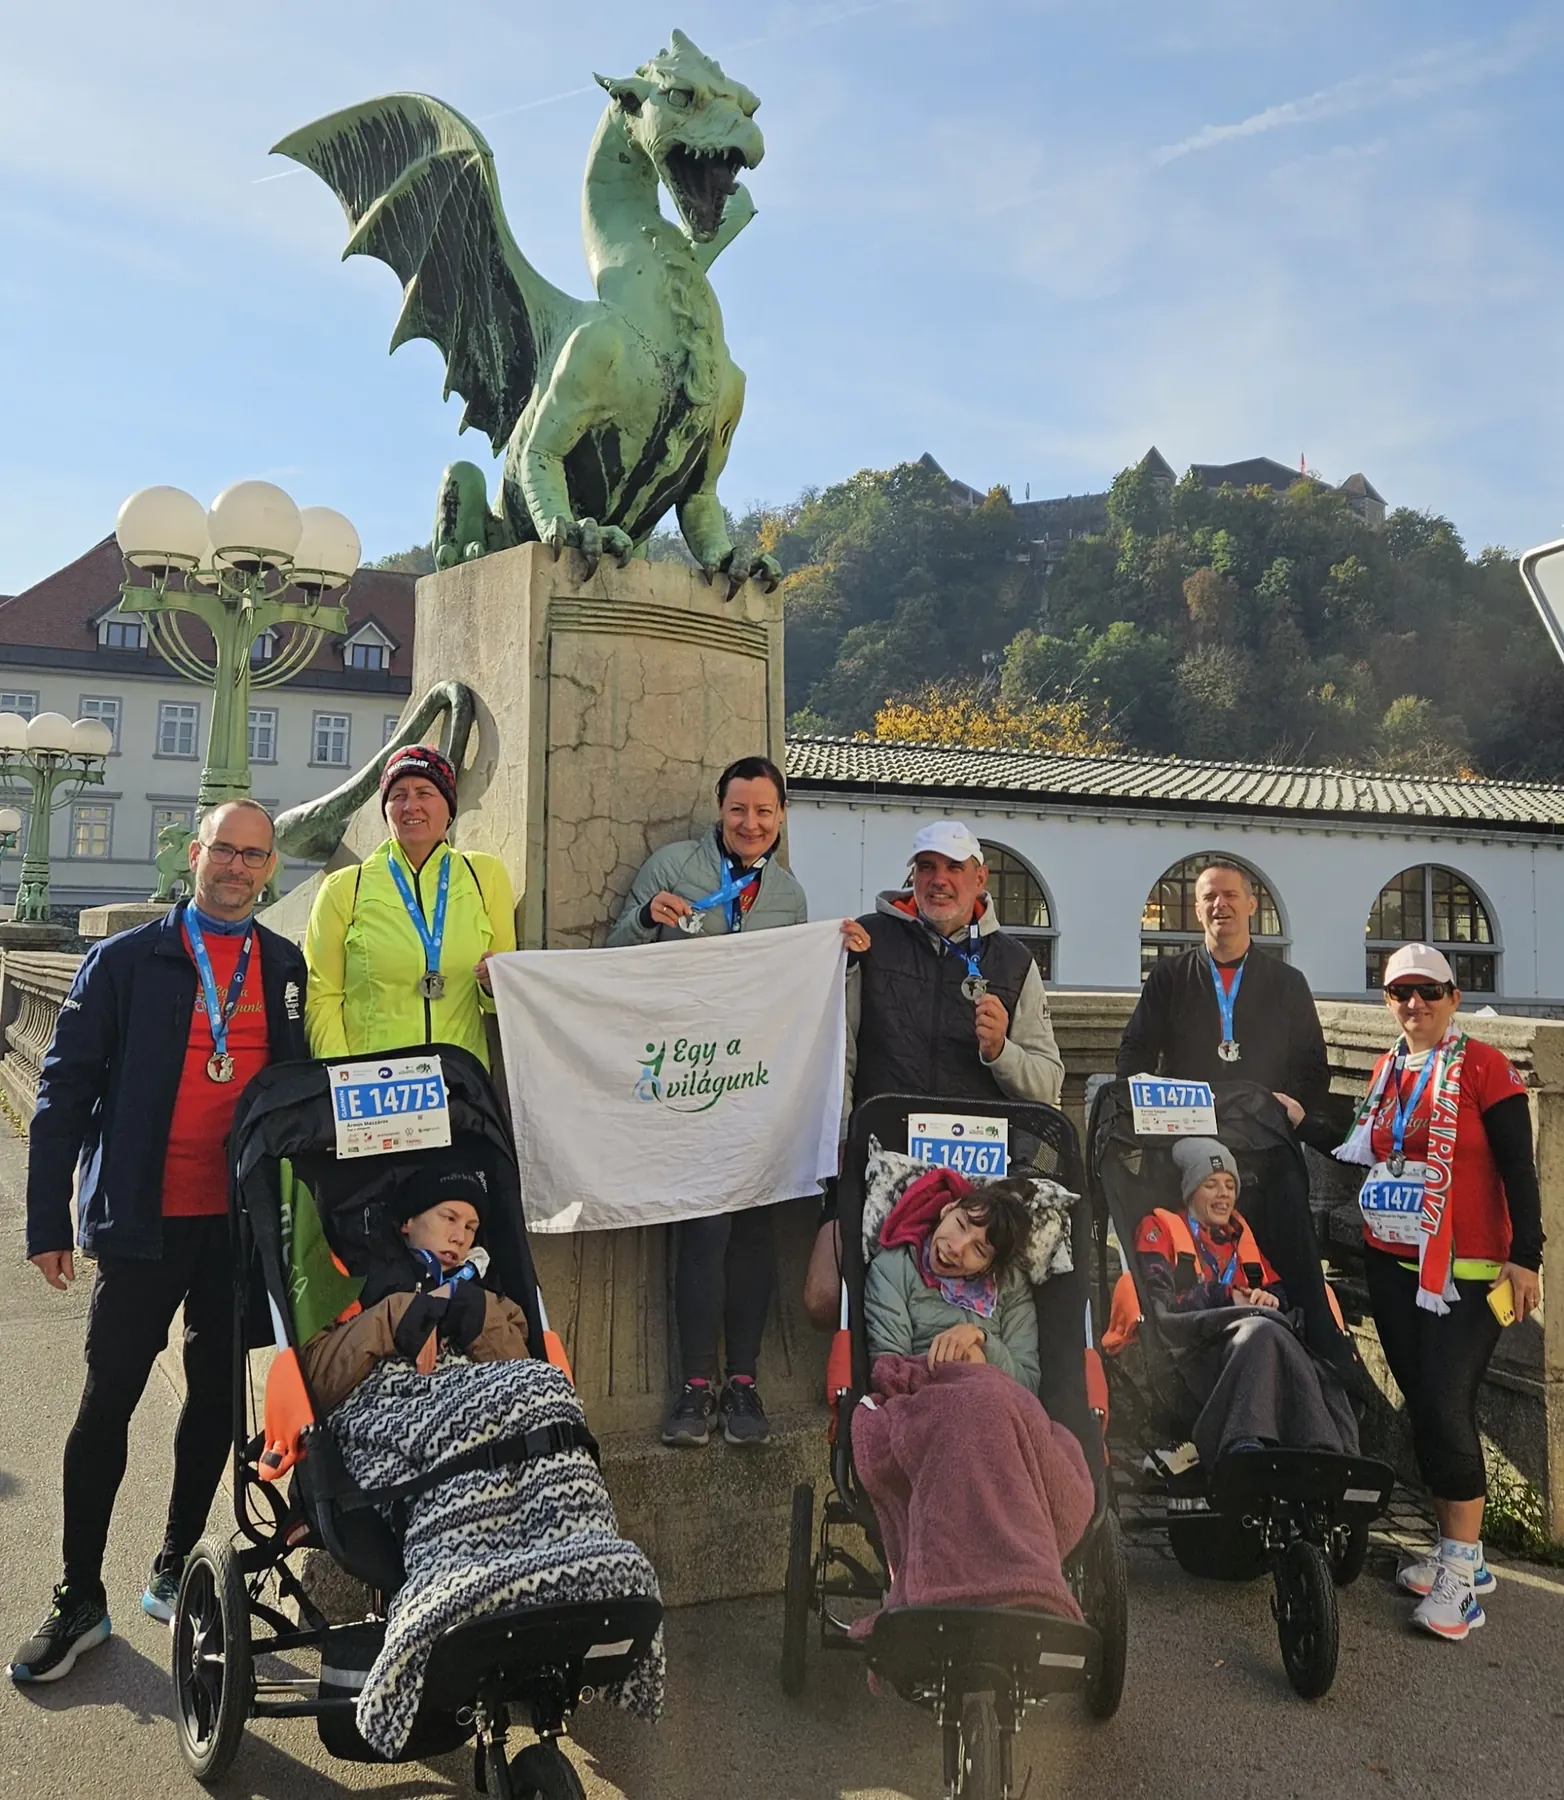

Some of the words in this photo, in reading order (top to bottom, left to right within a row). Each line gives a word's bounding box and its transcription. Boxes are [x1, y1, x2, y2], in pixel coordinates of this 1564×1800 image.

[673, 1038, 717, 1068] Egy
[726, 1038, 741, 1055] a
[666, 1060, 769, 1100] világunk
[348, 1089, 363, 1118] E
[369, 1081, 440, 1115] 14775
[1142, 1085, 1153, 1106] E
[1157, 1086, 1208, 1106] 14771
[940, 1144, 1002, 1173] 14767
[1369, 1184, 1378, 1209] E
[1382, 1186, 1424, 1212] 1477
